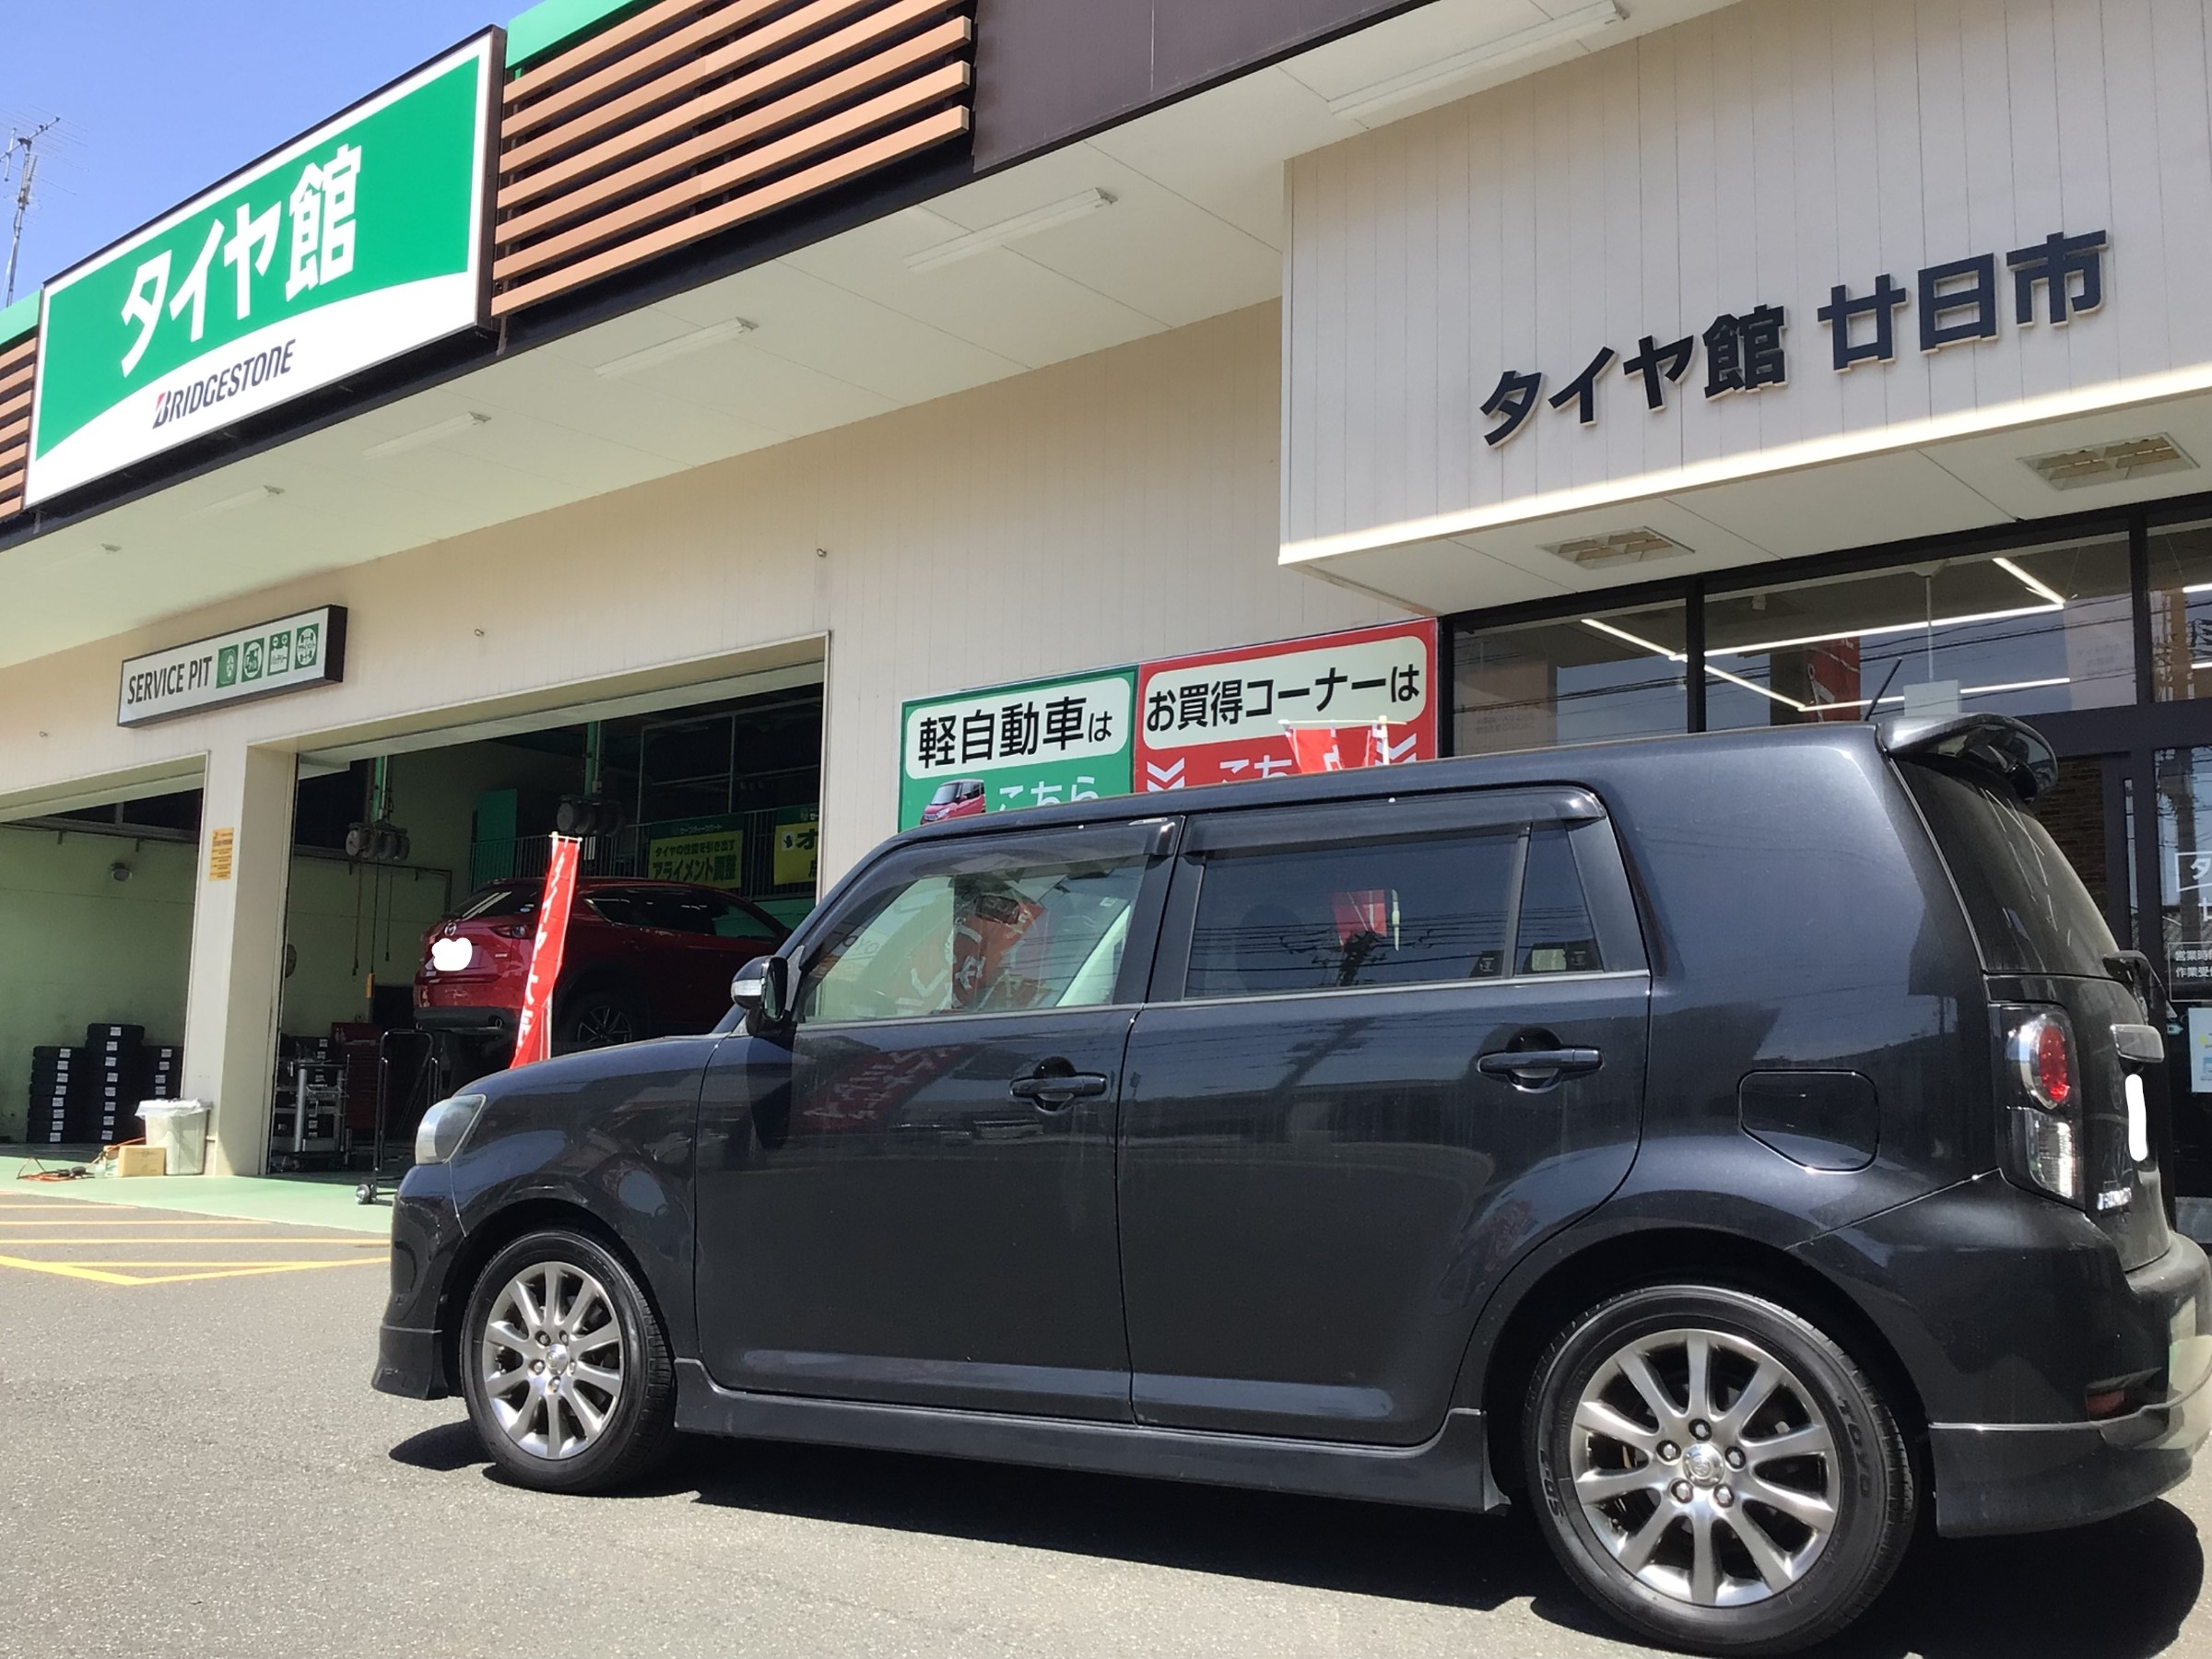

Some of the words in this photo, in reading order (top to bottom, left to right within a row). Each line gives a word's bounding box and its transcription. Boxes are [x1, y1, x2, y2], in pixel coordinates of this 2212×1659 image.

[120, 143, 362, 378] タイヤ館
[1479, 302, 1789, 448] タイヤ館
[1817, 228, 2111, 372] 廿日市
[152, 338, 297, 429] BRIDGESTONE
[127, 663, 185, 705] SERVICE
[188, 655, 213, 690] PIT
[1147, 663, 1420, 733] お買得コーナーは
[918, 695, 1113, 769] 軽自動車は
[1219, 754, 1292, 782] こち
